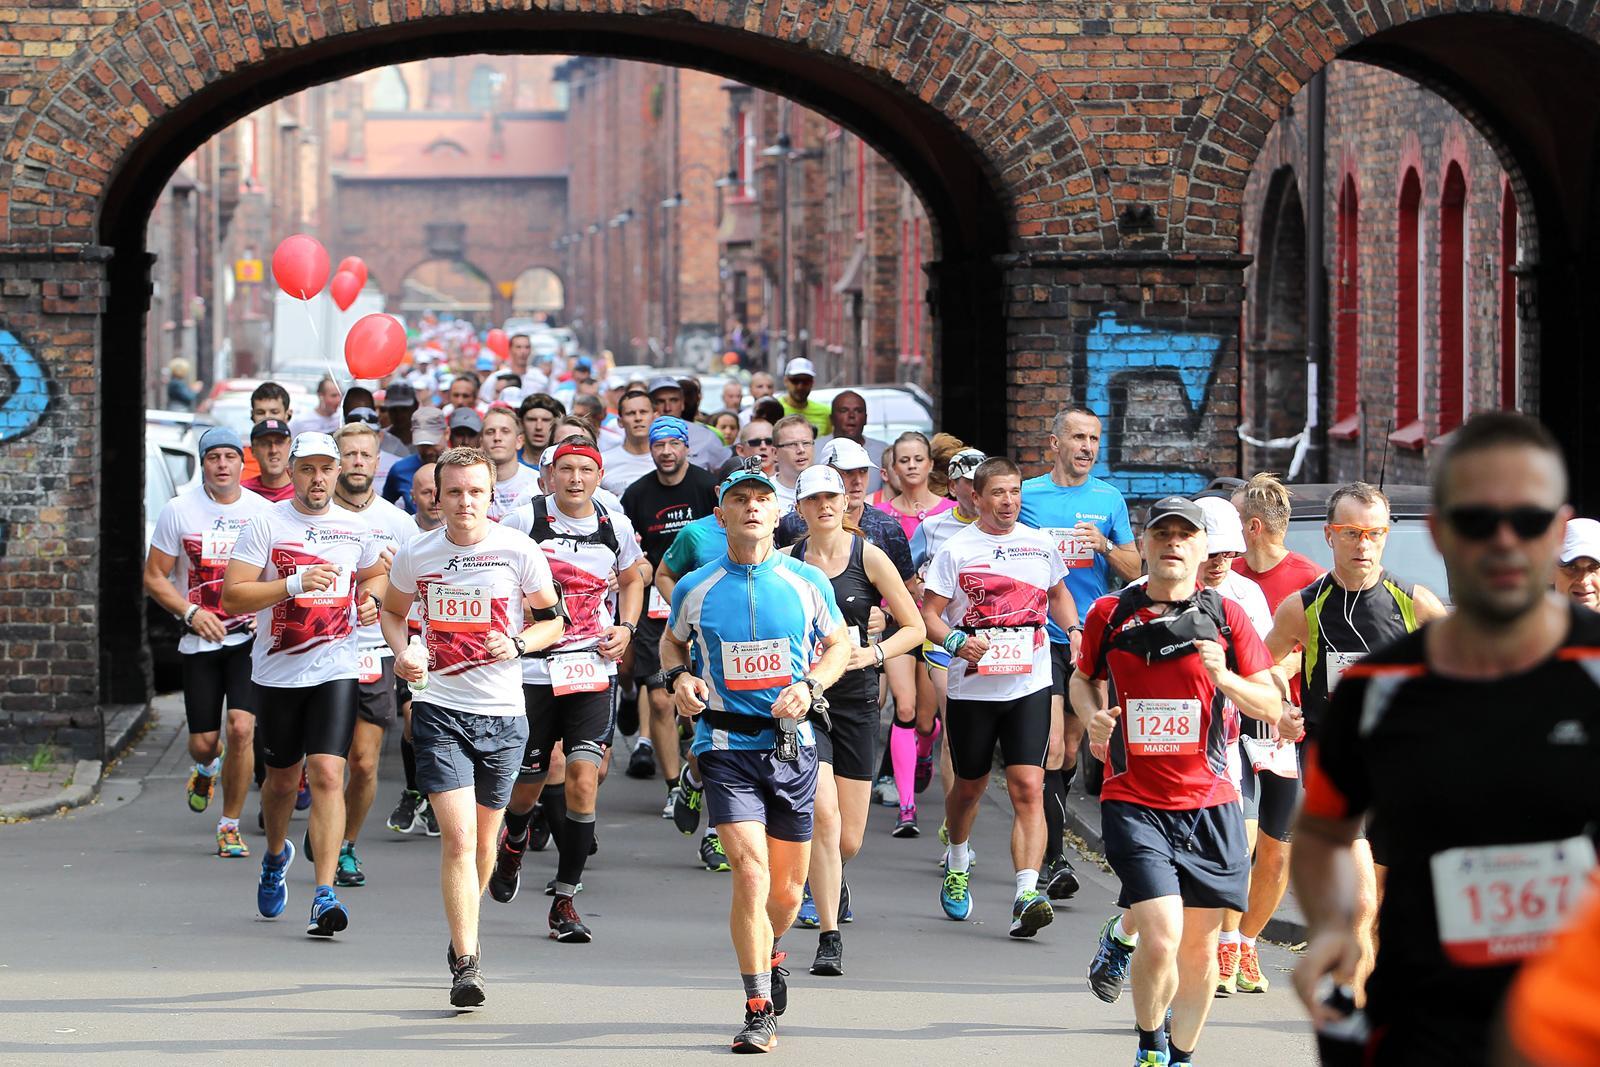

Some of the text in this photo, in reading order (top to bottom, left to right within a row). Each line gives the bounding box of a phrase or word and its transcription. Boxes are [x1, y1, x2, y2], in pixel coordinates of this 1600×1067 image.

[1058, 540, 1087, 554] 412
[436, 599, 482, 617] 1810
[991, 644, 1021, 660] 326
[563, 663, 595, 680] 290
[732, 653, 782, 674] 1608
[988, 665, 1025, 673] KRZYSZTOF
[1136, 715, 1190, 736] 1248
[1143, 744, 1180, 753] MARCIN
[1459, 875, 1571, 926] 1367
